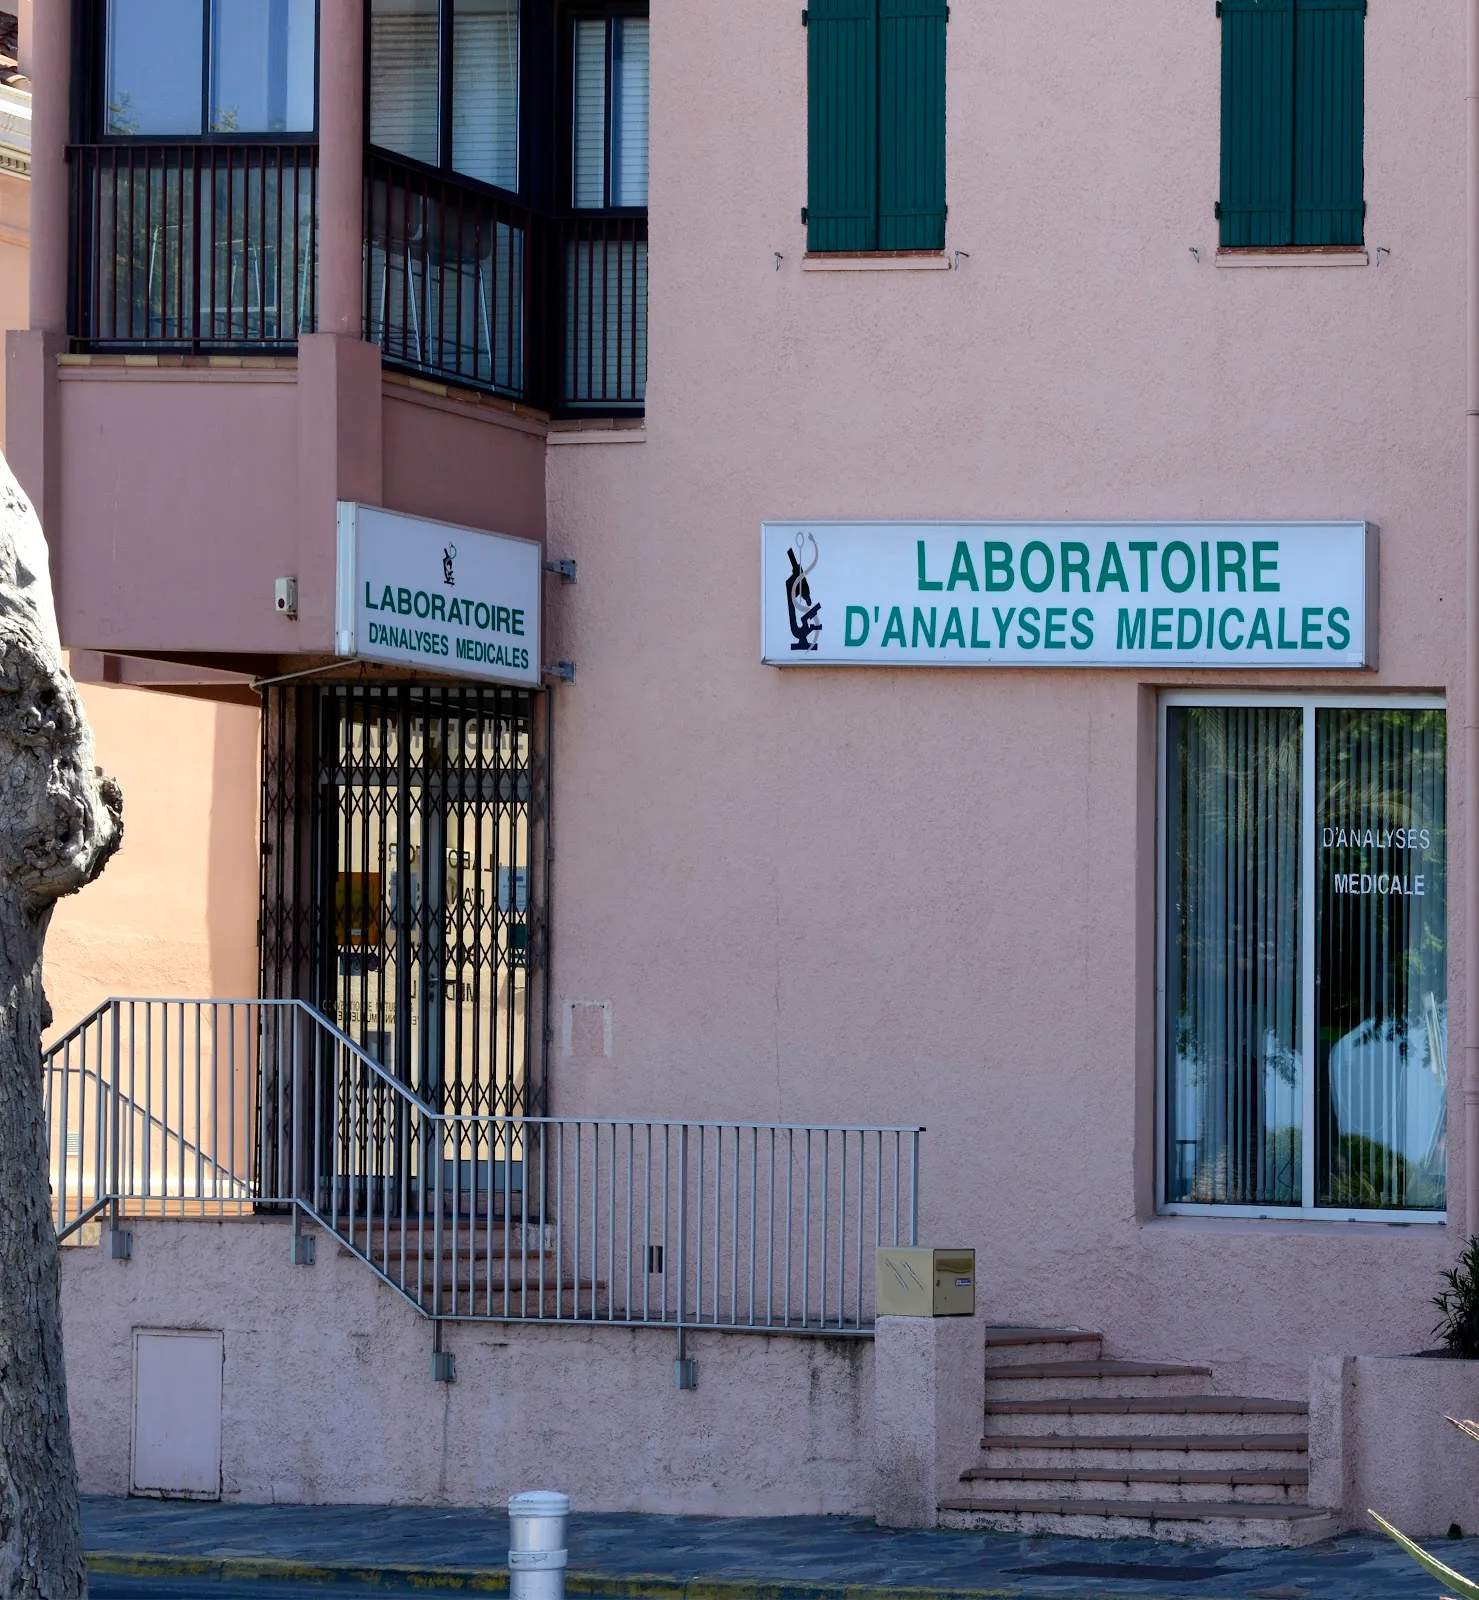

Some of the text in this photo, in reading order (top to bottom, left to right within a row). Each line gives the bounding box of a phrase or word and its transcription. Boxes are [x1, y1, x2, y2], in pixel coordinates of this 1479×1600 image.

[916, 540, 1280, 593] LABORATOIRE
[365, 581, 525, 636] LABORATOIRE
[844, 605, 1351, 650] D'ANALYSES MEDICALES
[369, 622, 529, 670] D'ANALYSES MEDICALES
[1323, 827, 1430, 849] D'ANALYSES
[1334, 874, 1425, 896] MEDICALE
